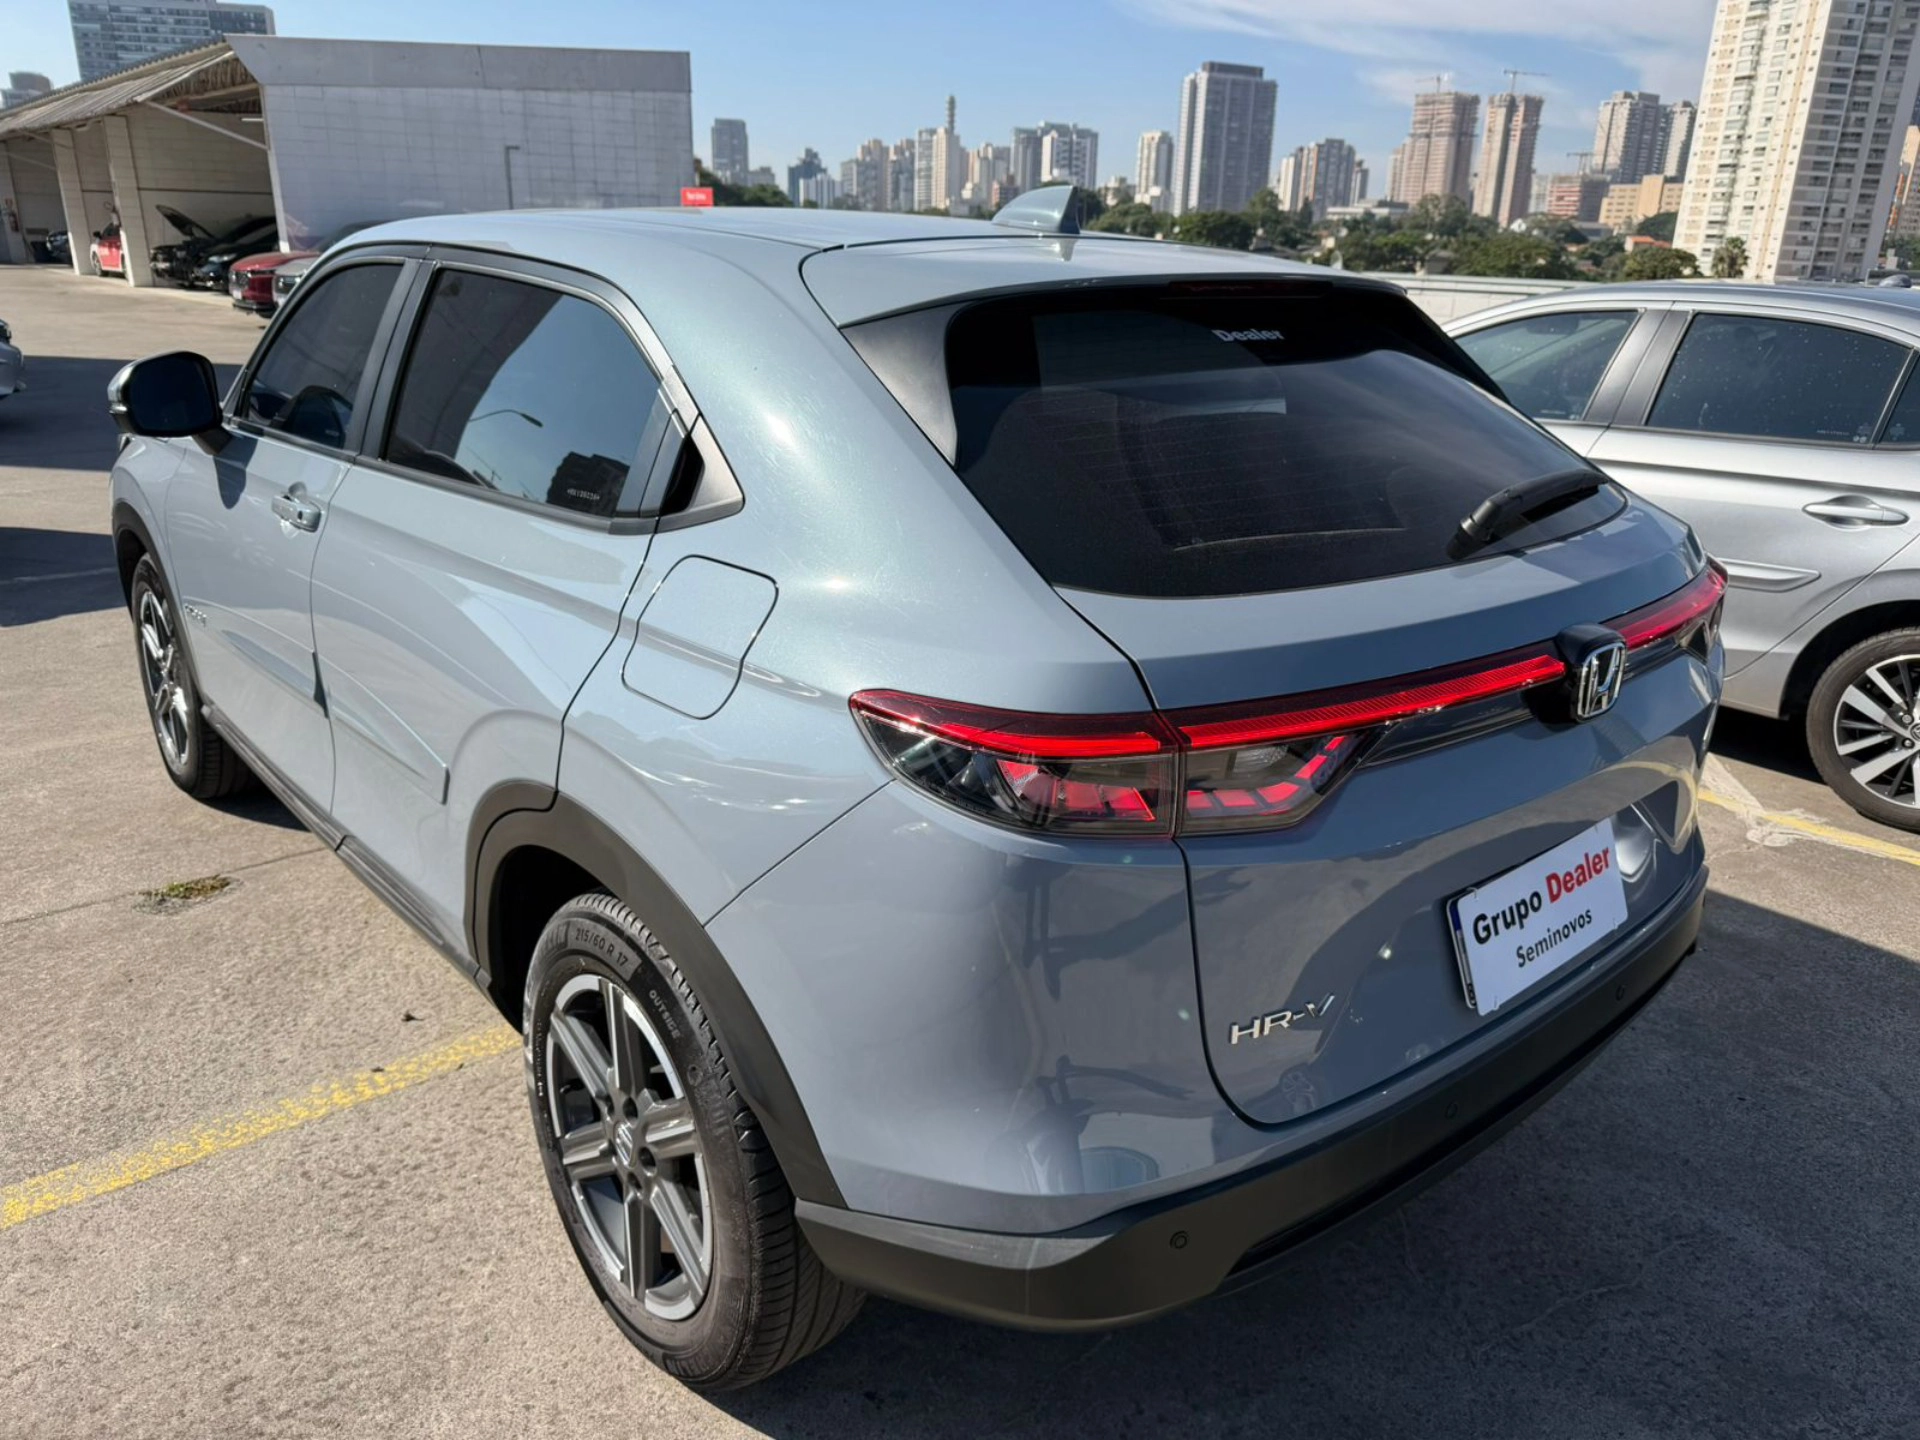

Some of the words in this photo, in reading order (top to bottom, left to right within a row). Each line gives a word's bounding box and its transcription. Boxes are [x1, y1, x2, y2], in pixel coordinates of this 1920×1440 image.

[1211, 328, 1285, 341] Dealer
[1473, 891, 1542, 945] Grupo
[1545, 847, 1610, 903] Dealer
[575, 928, 606, 950] 215/60
[606, 943, 615, 957] R
[617, 952, 628, 967] 17
[1516, 909, 1593, 968] Seminovos
[1229, 995, 1335, 1045] HR-V
